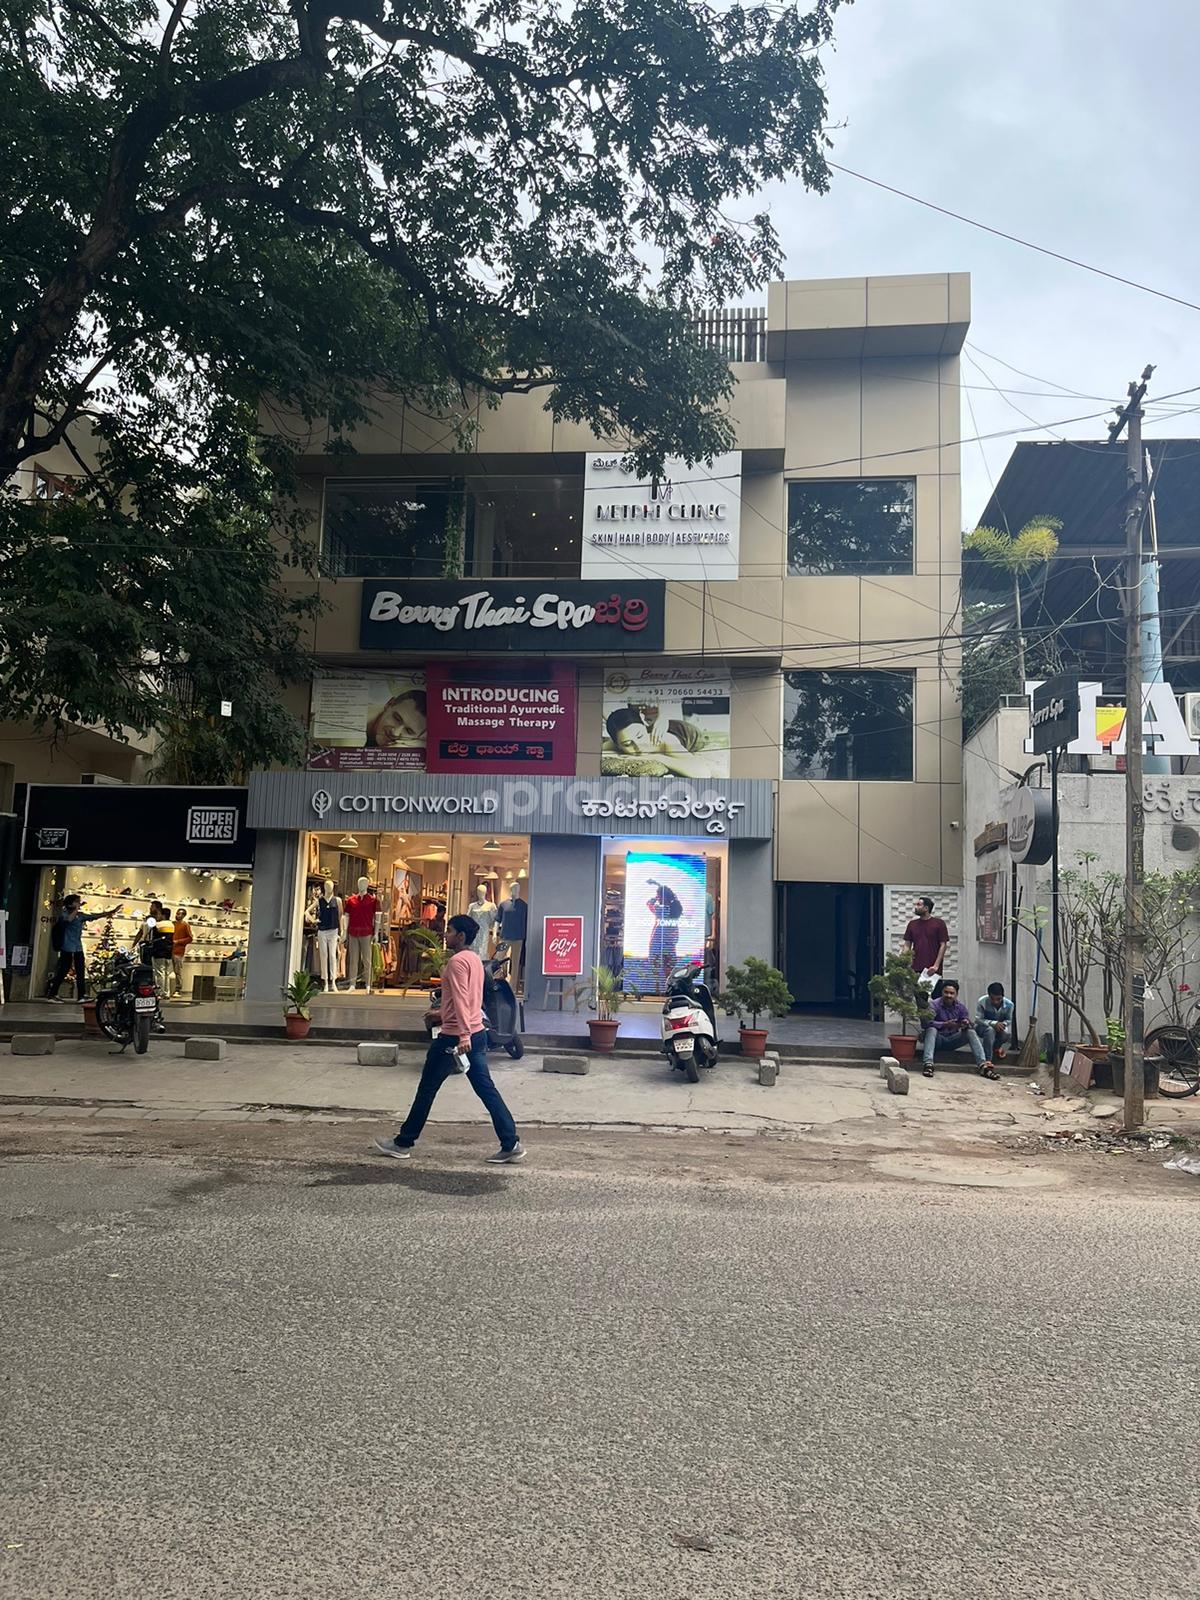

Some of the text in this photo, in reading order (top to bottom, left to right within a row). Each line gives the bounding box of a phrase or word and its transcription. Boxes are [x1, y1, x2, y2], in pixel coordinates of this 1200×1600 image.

[597, 504, 726, 521] METPHI CLINIC
[592, 532, 613, 544] SKIN
[619, 532, 641, 544] HAIR
[646, 532, 670, 545] BODY
[369, 590, 596, 631] Berry Thai Spa
[442, 688, 559, 703] INTRODUCING
[667, 688, 694, 696] 70660
[697, 688, 723, 696] 54433
[445, 704, 565, 716] Traditional Ayurvedic
[457, 717, 556, 729] Massage Therapy
[339, 795, 499, 815] COTTONWORLD
[192, 812, 233, 825] SUPER
[191, 825, 232, 838] KICKS
[549, 937, 578, 953] 60%
